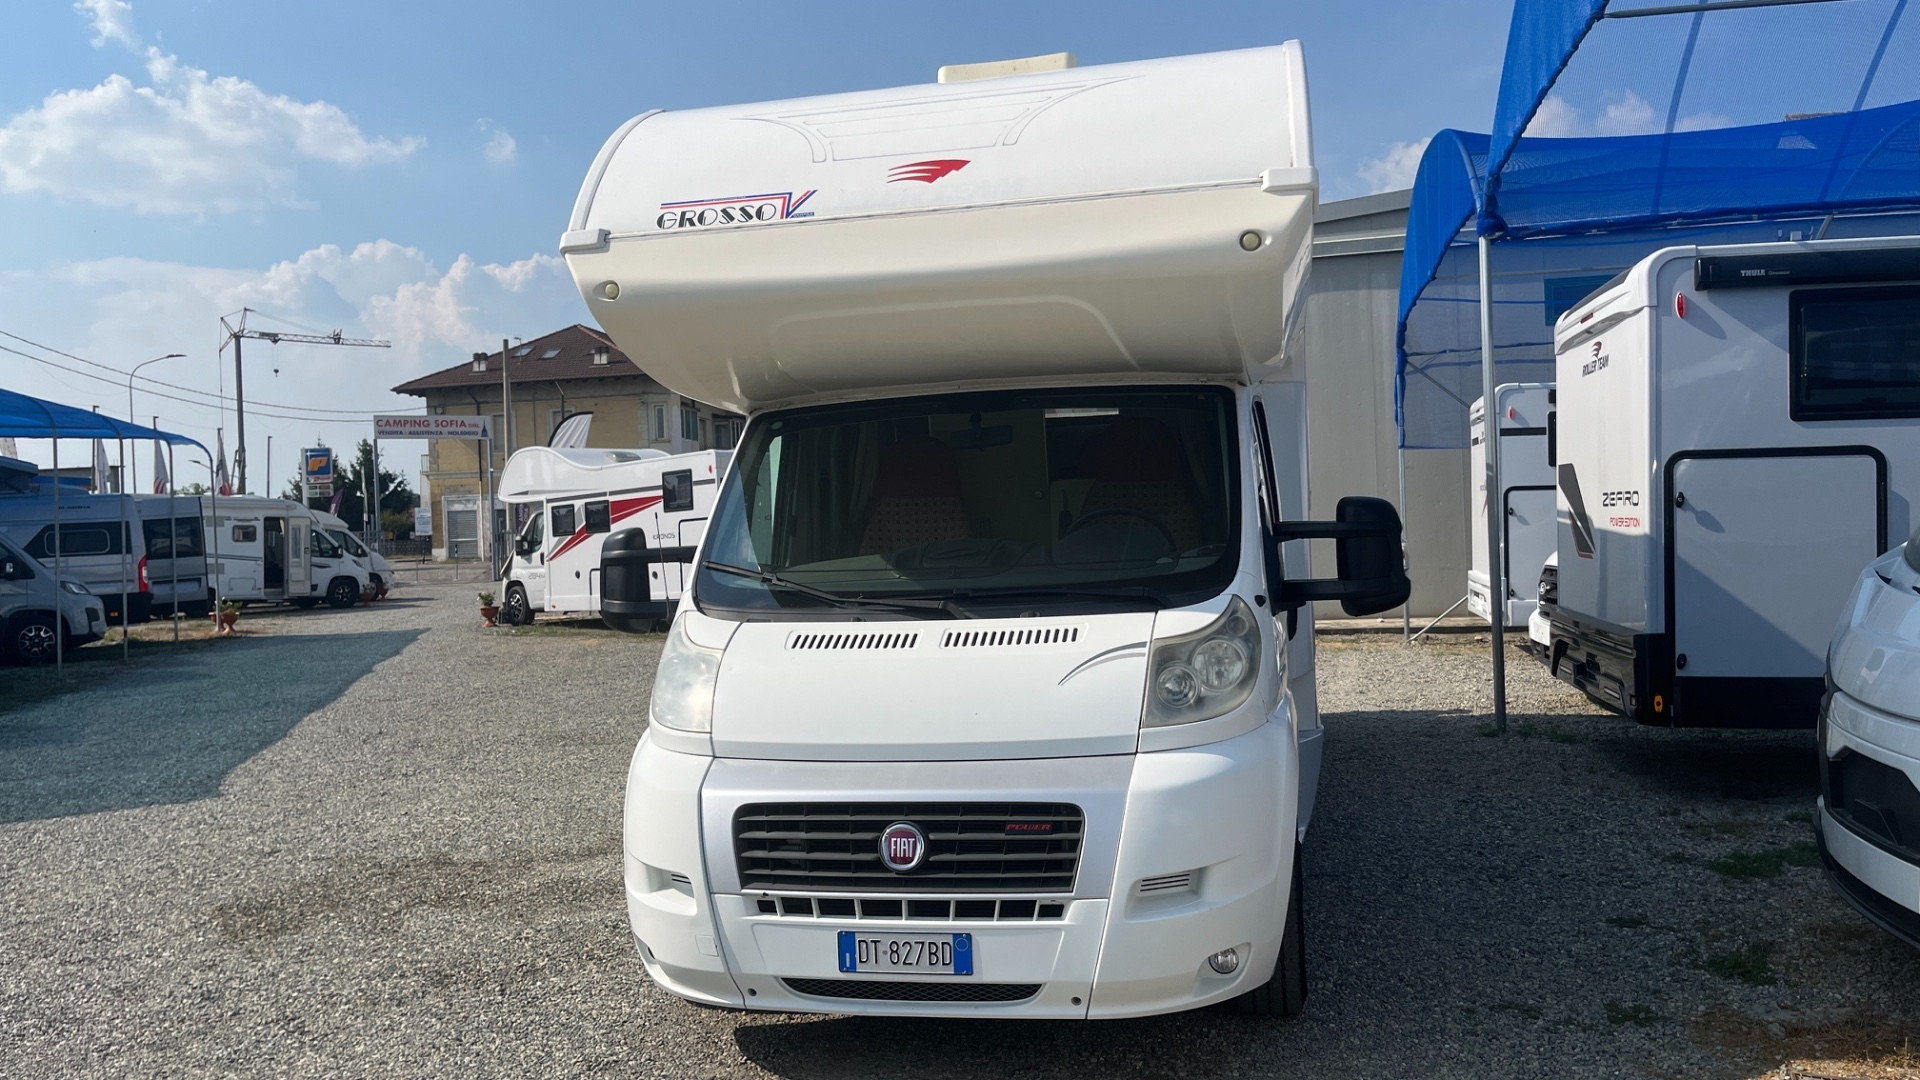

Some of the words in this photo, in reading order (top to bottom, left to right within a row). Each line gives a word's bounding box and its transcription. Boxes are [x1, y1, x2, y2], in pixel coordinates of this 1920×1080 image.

[657, 203, 776, 229] GROSSO
[1582, 360, 1597, 377] ROLLER
[1597, 353, 1609, 370] TEAM
[376, 419, 430, 428] CAMPING
[434, 419, 467, 428] SOFIA
[1602, 490, 1640, 507] ZEFIRO
[1006, 823, 1052, 831] POWER
[891, 837, 915, 858] FIAT
